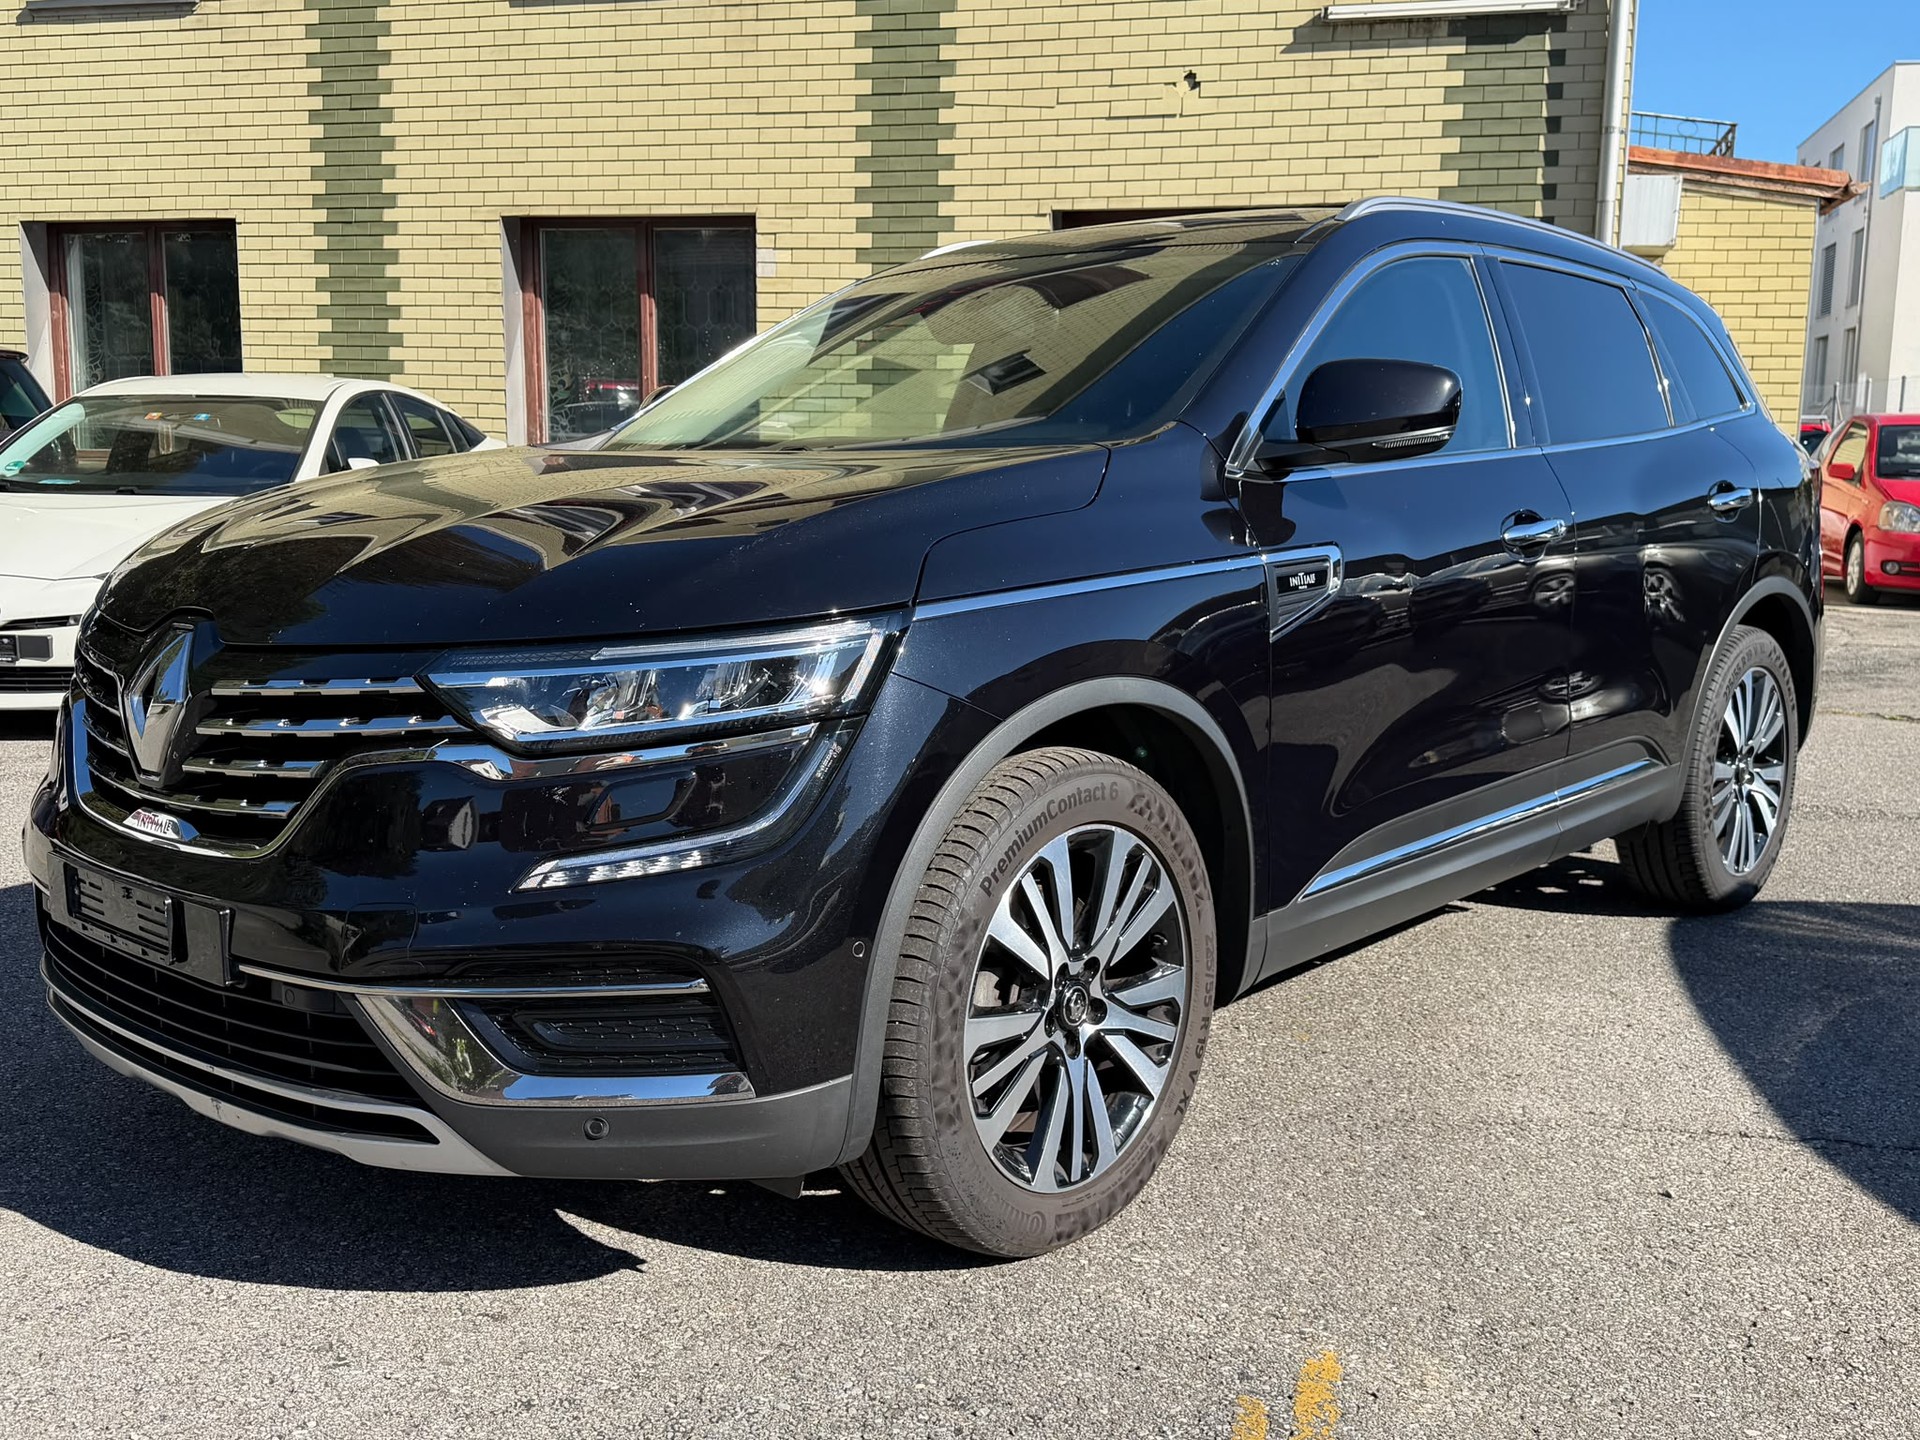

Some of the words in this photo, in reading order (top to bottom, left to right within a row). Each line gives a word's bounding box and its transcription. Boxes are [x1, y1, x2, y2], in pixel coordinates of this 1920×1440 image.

[979, 782, 1106, 898] PremiumContact
[1109, 781, 1120, 801] 6
[1194, 1036, 1207, 1060] 19
[1188, 1069, 1200, 1084] V
[1173, 1089, 1191, 1117] XL
